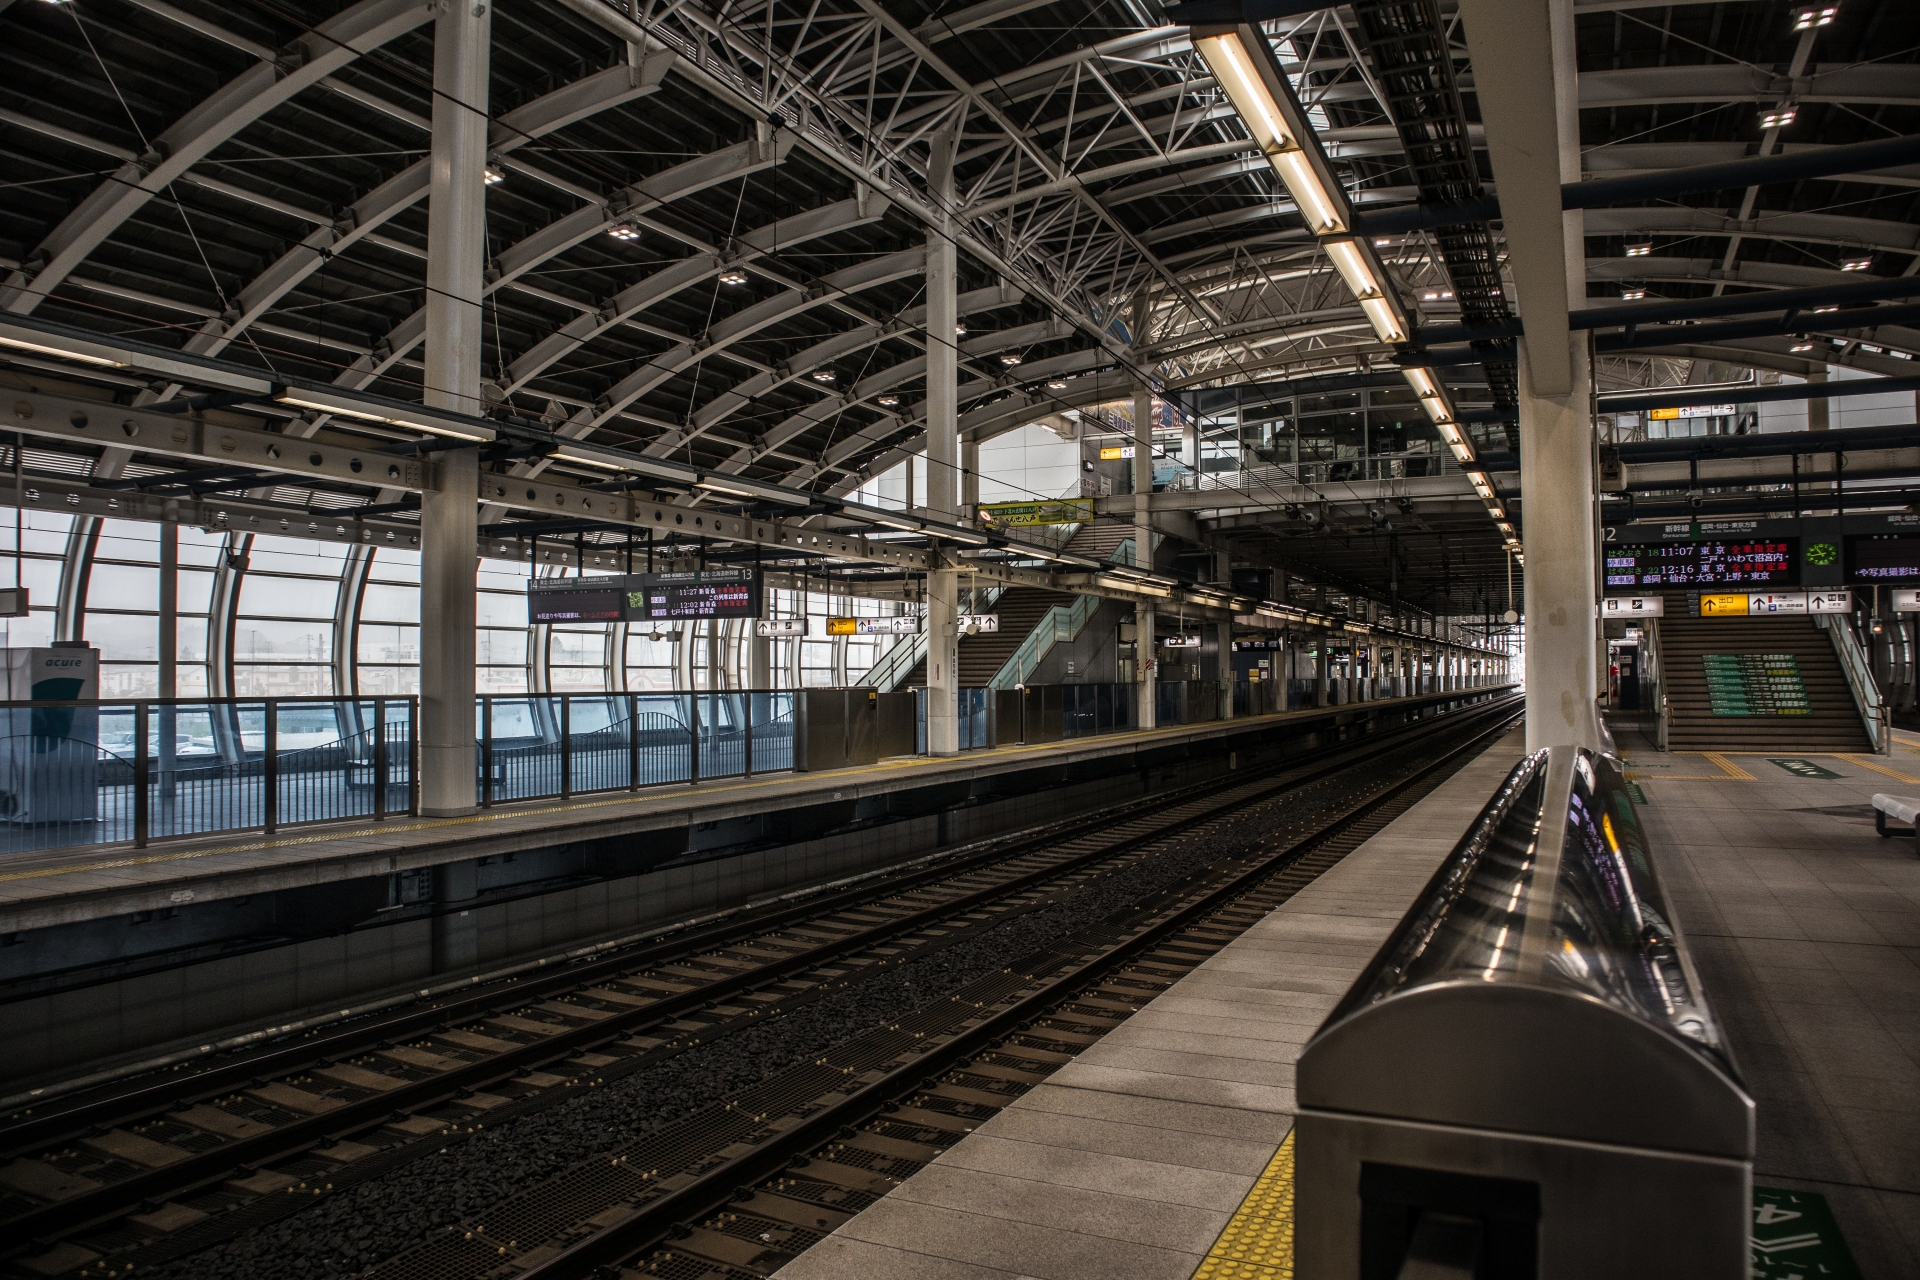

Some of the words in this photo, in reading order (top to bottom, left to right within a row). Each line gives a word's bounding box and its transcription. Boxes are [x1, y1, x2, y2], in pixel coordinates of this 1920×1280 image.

[1664, 524, 1690, 533] 新幹線
[1661, 547, 1694, 556] 11:07
[1661, 564, 1694, 574] 12:16
[1855, 566, 1920, 577] や写真撮影は、
[741, 568, 753, 581] 13
[679, 588, 698, 596] 11:27
[45, 659, 82, 667] acure
